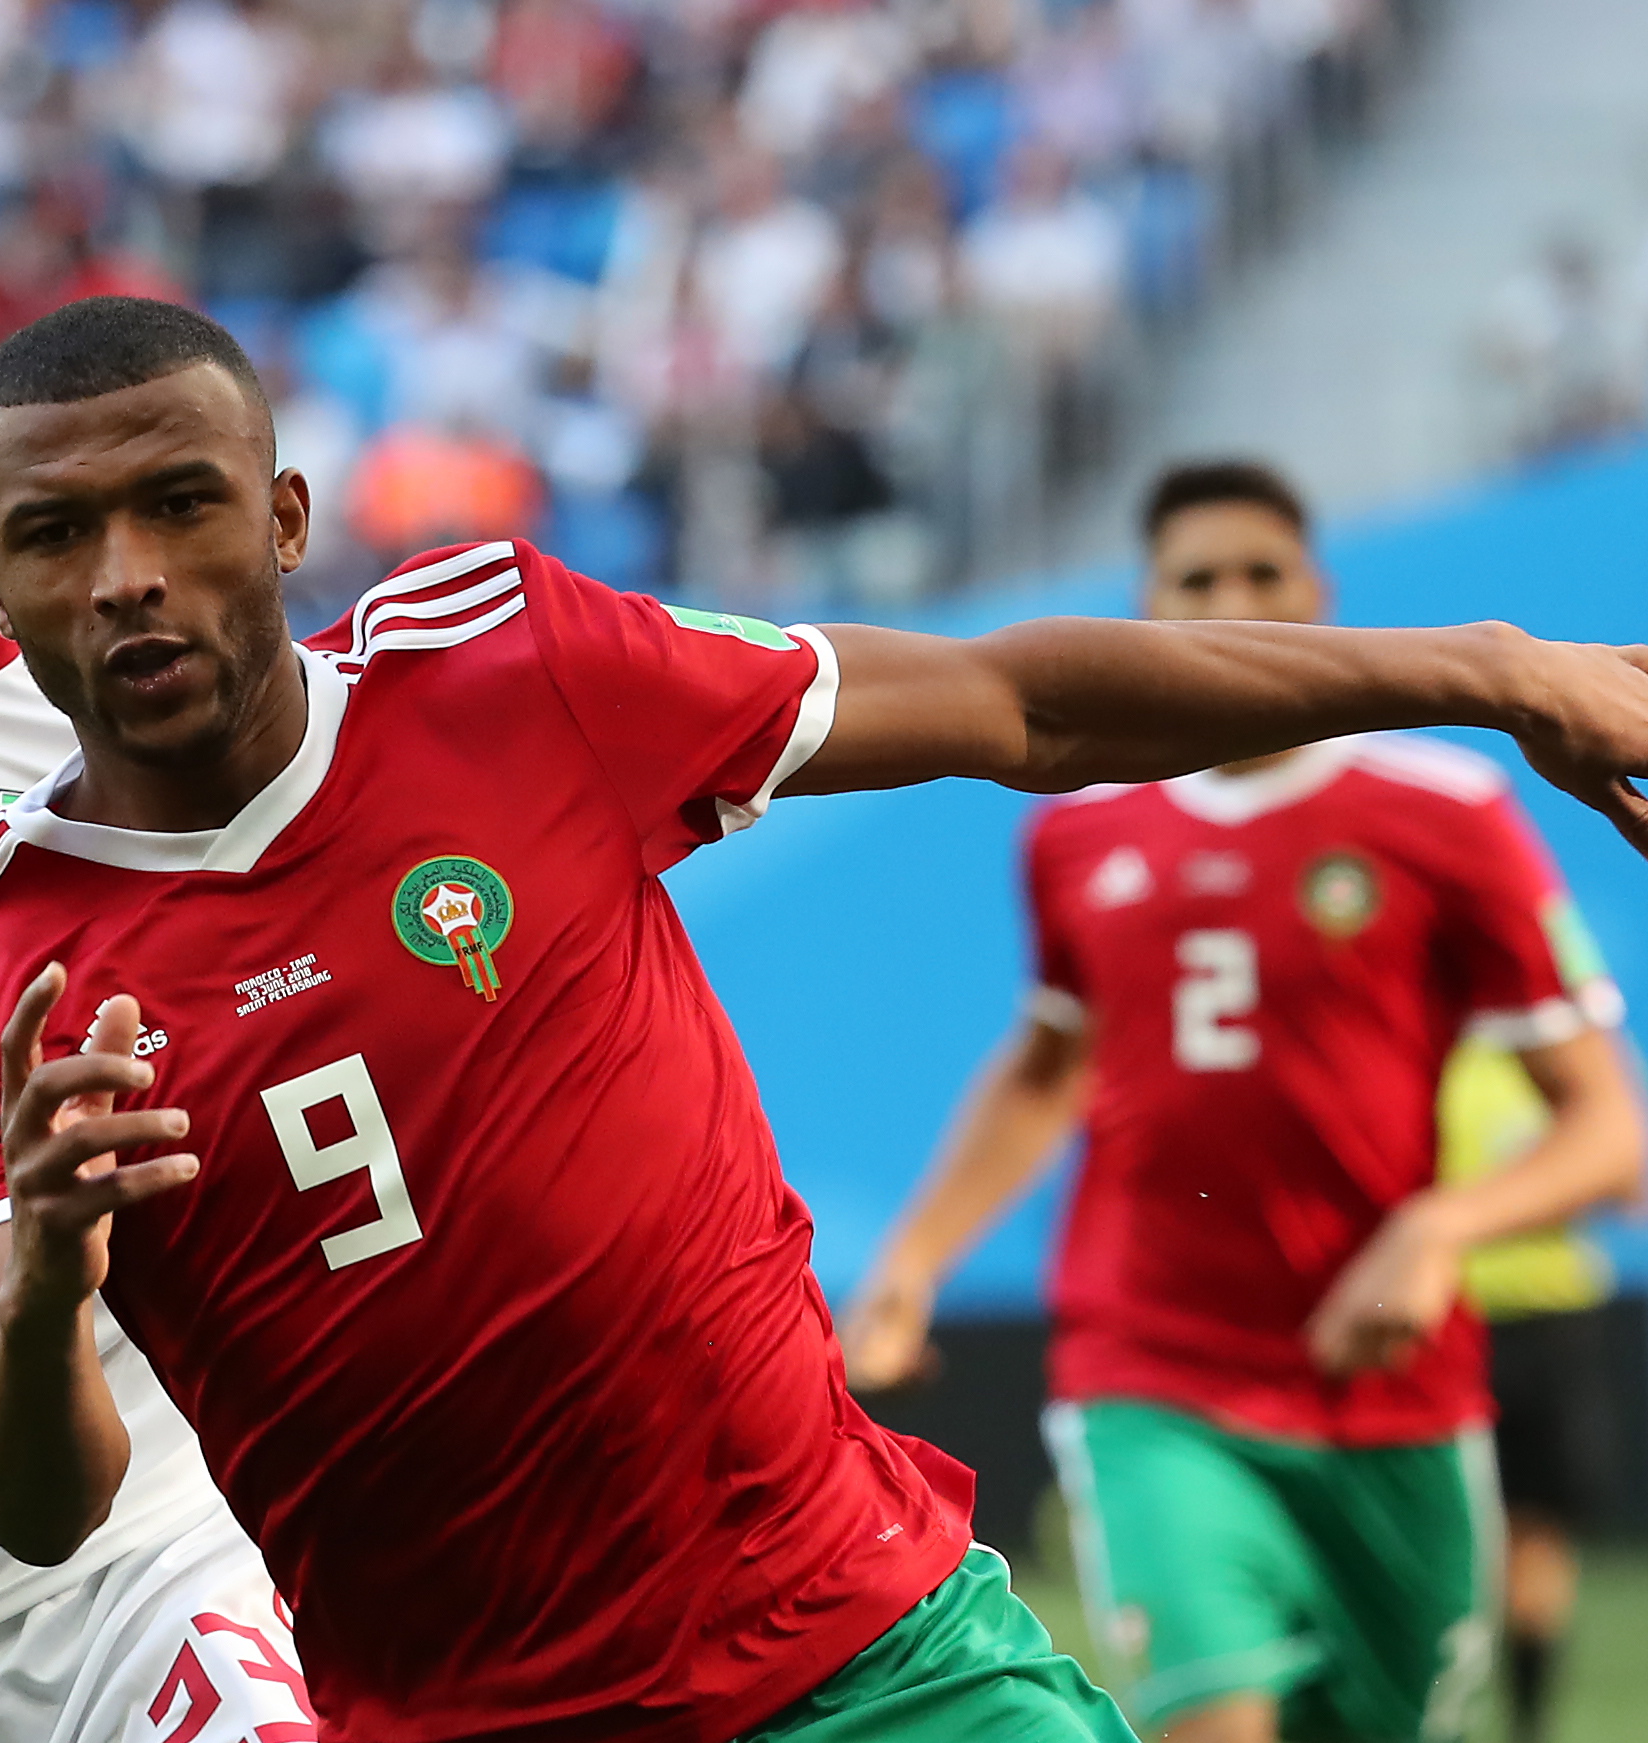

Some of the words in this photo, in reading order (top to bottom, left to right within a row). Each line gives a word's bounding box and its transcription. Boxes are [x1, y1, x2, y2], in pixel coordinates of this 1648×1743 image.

[455, 941, 484, 958] FRMF
[234, 967, 282, 995] MOROCCO
[289, 953, 317, 972] IRAN
[236, 996, 267, 1017] SAINT
[268, 969, 332, 1003] PETERSBURG
[247, 988, 260, 1001] 15
[260, 976, 287, 996] JUNE
[287, 966, 312, 983] 2018
[1172, 927, 1262, 1072] 2
[260, 1053, 423, 1270] 9
